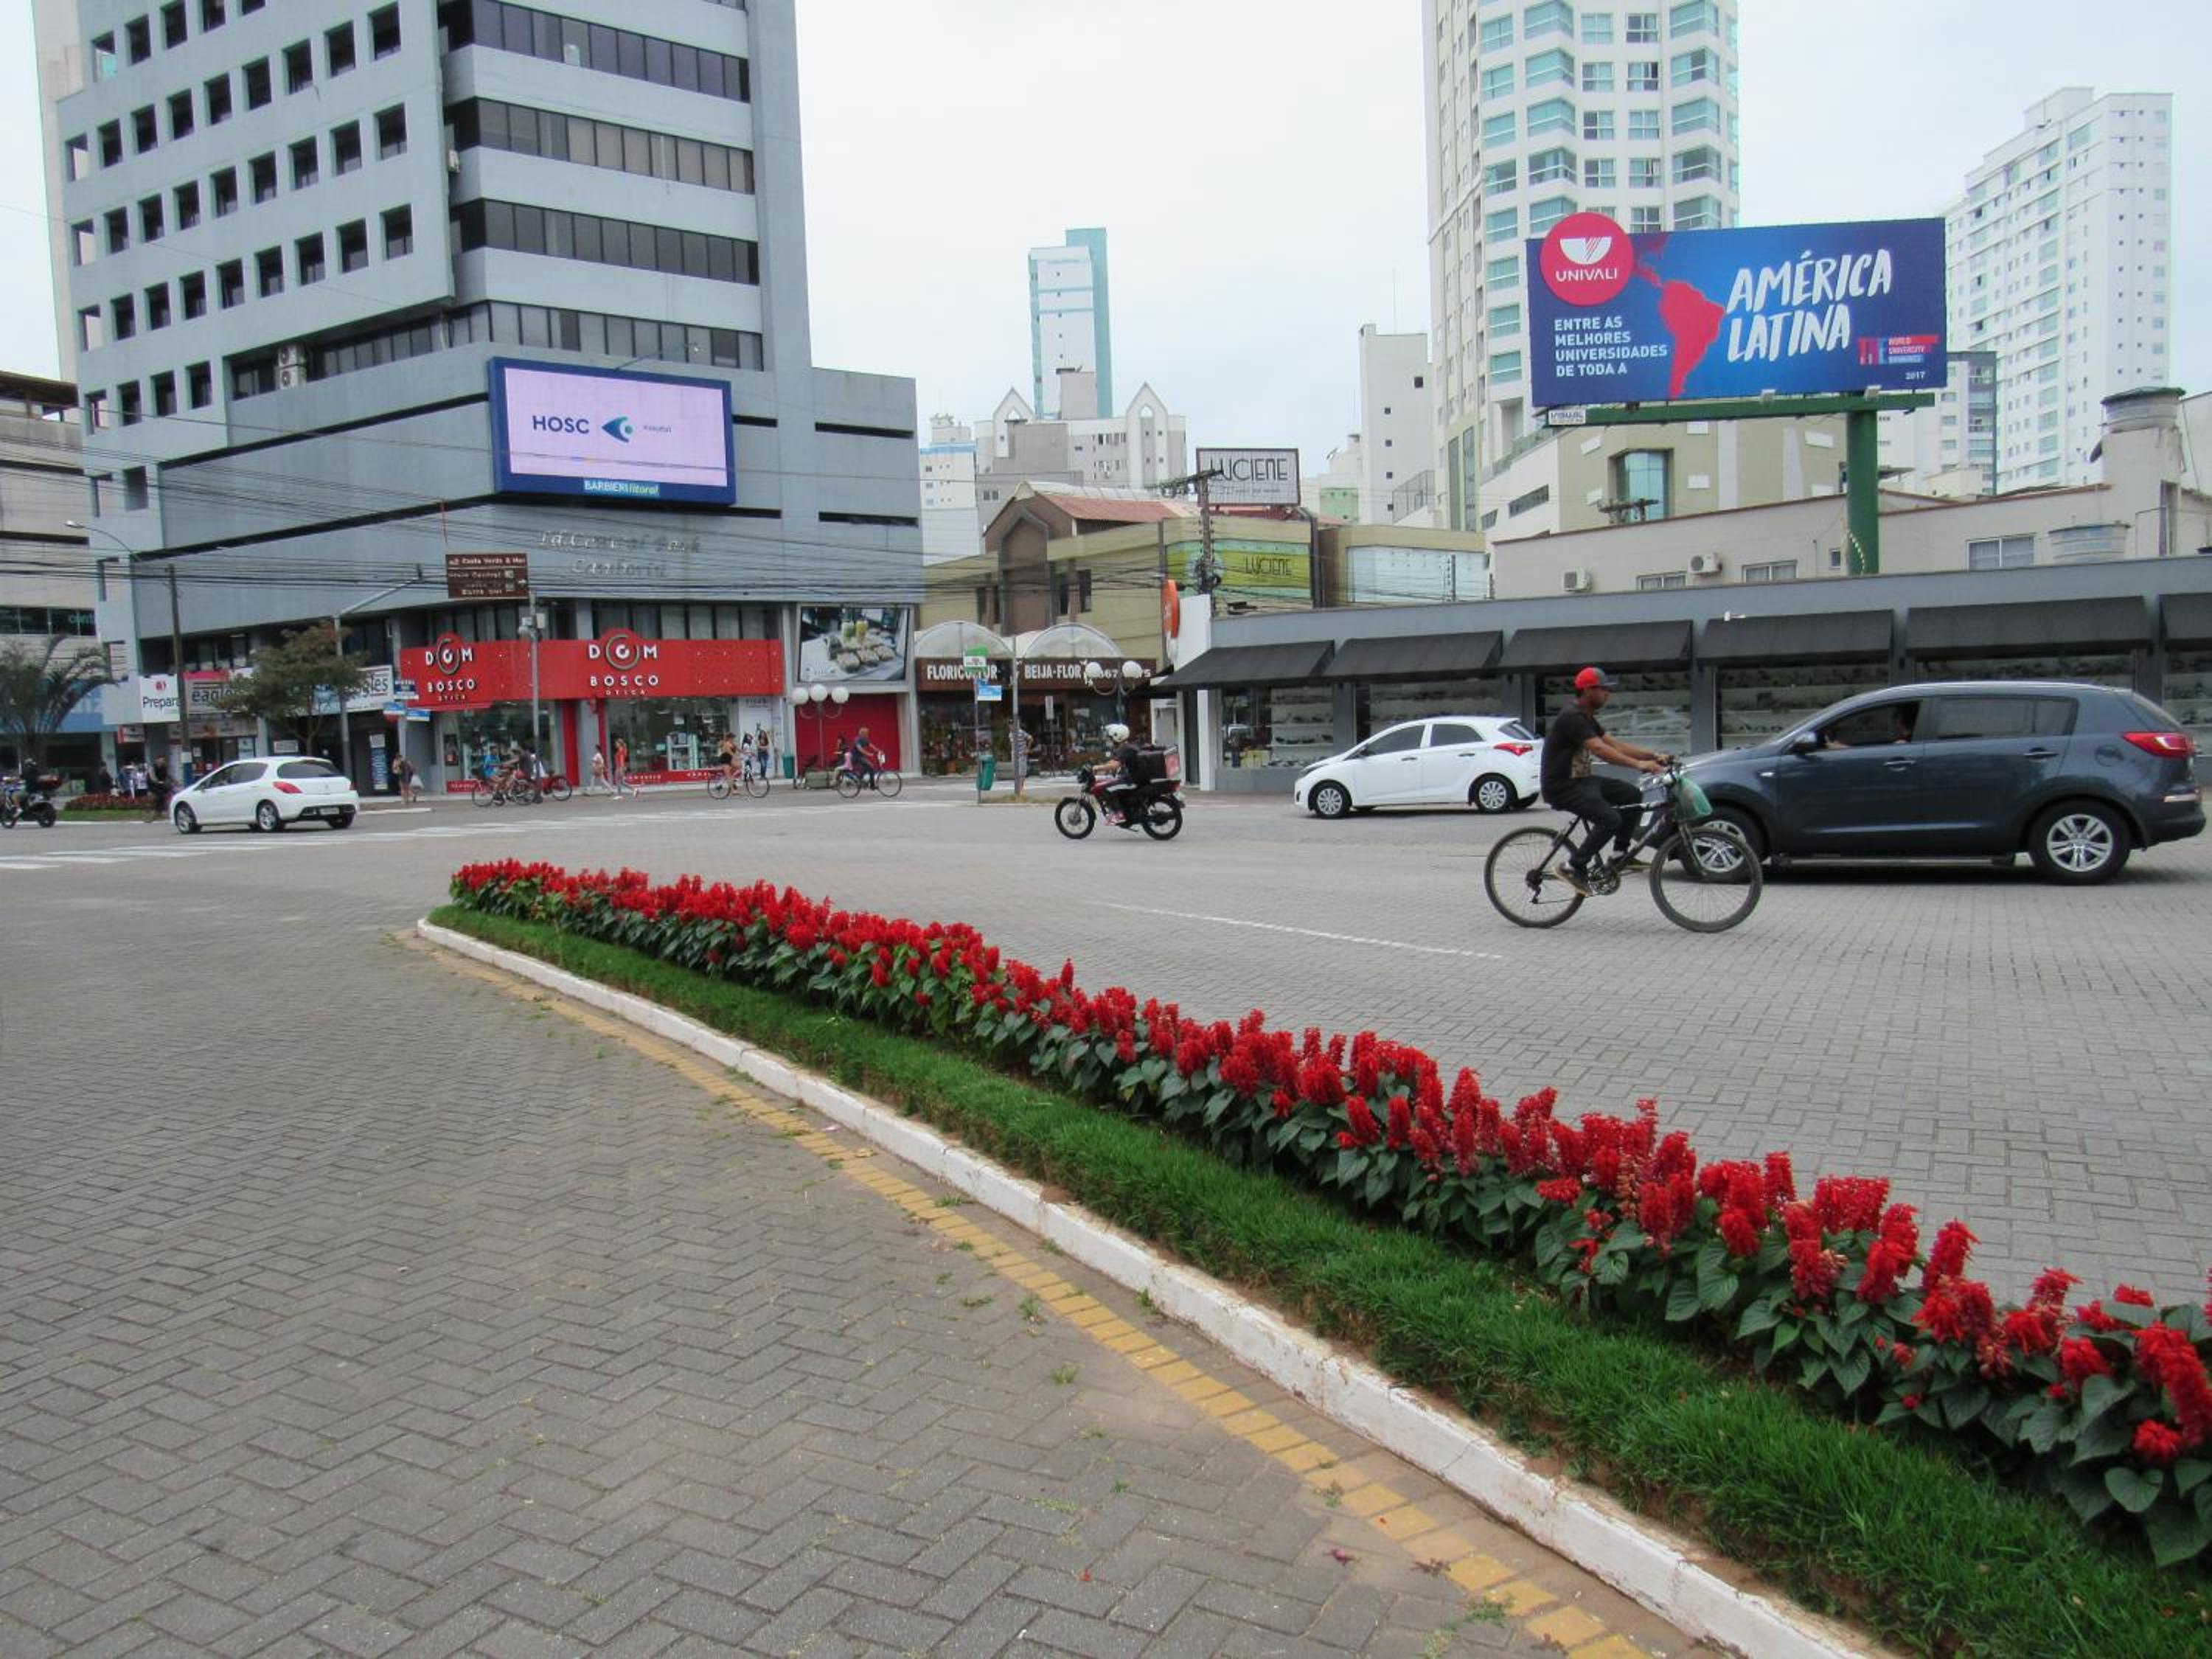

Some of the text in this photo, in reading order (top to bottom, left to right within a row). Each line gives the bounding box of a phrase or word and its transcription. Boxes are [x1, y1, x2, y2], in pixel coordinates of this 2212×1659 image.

[1555, 268, 1617, 282] UNIVALI
[1726, 248, 1892, 315] AMÉRICA
[1554, 316, 1622, 331] ENTRE AS
[1555, 331, 1631, 347] MELHORES
[1728, 304, 1851, 363] LATINA
[1555, 344, 1667, 361] UNIVERSIDADES
[1557, 363, 1627, 377] DE TODA A
[1905, 371, 1925, 380] 2017
[532, 415, 590, 434] HOSC
[1245, 555, 1292, 576] LUCIENE
[1025, 664, 1081, 679] BEIJA-FLOR
[427, 679, 474, 692] BOSCO
[590, 675, 658, 686] BOSCO
